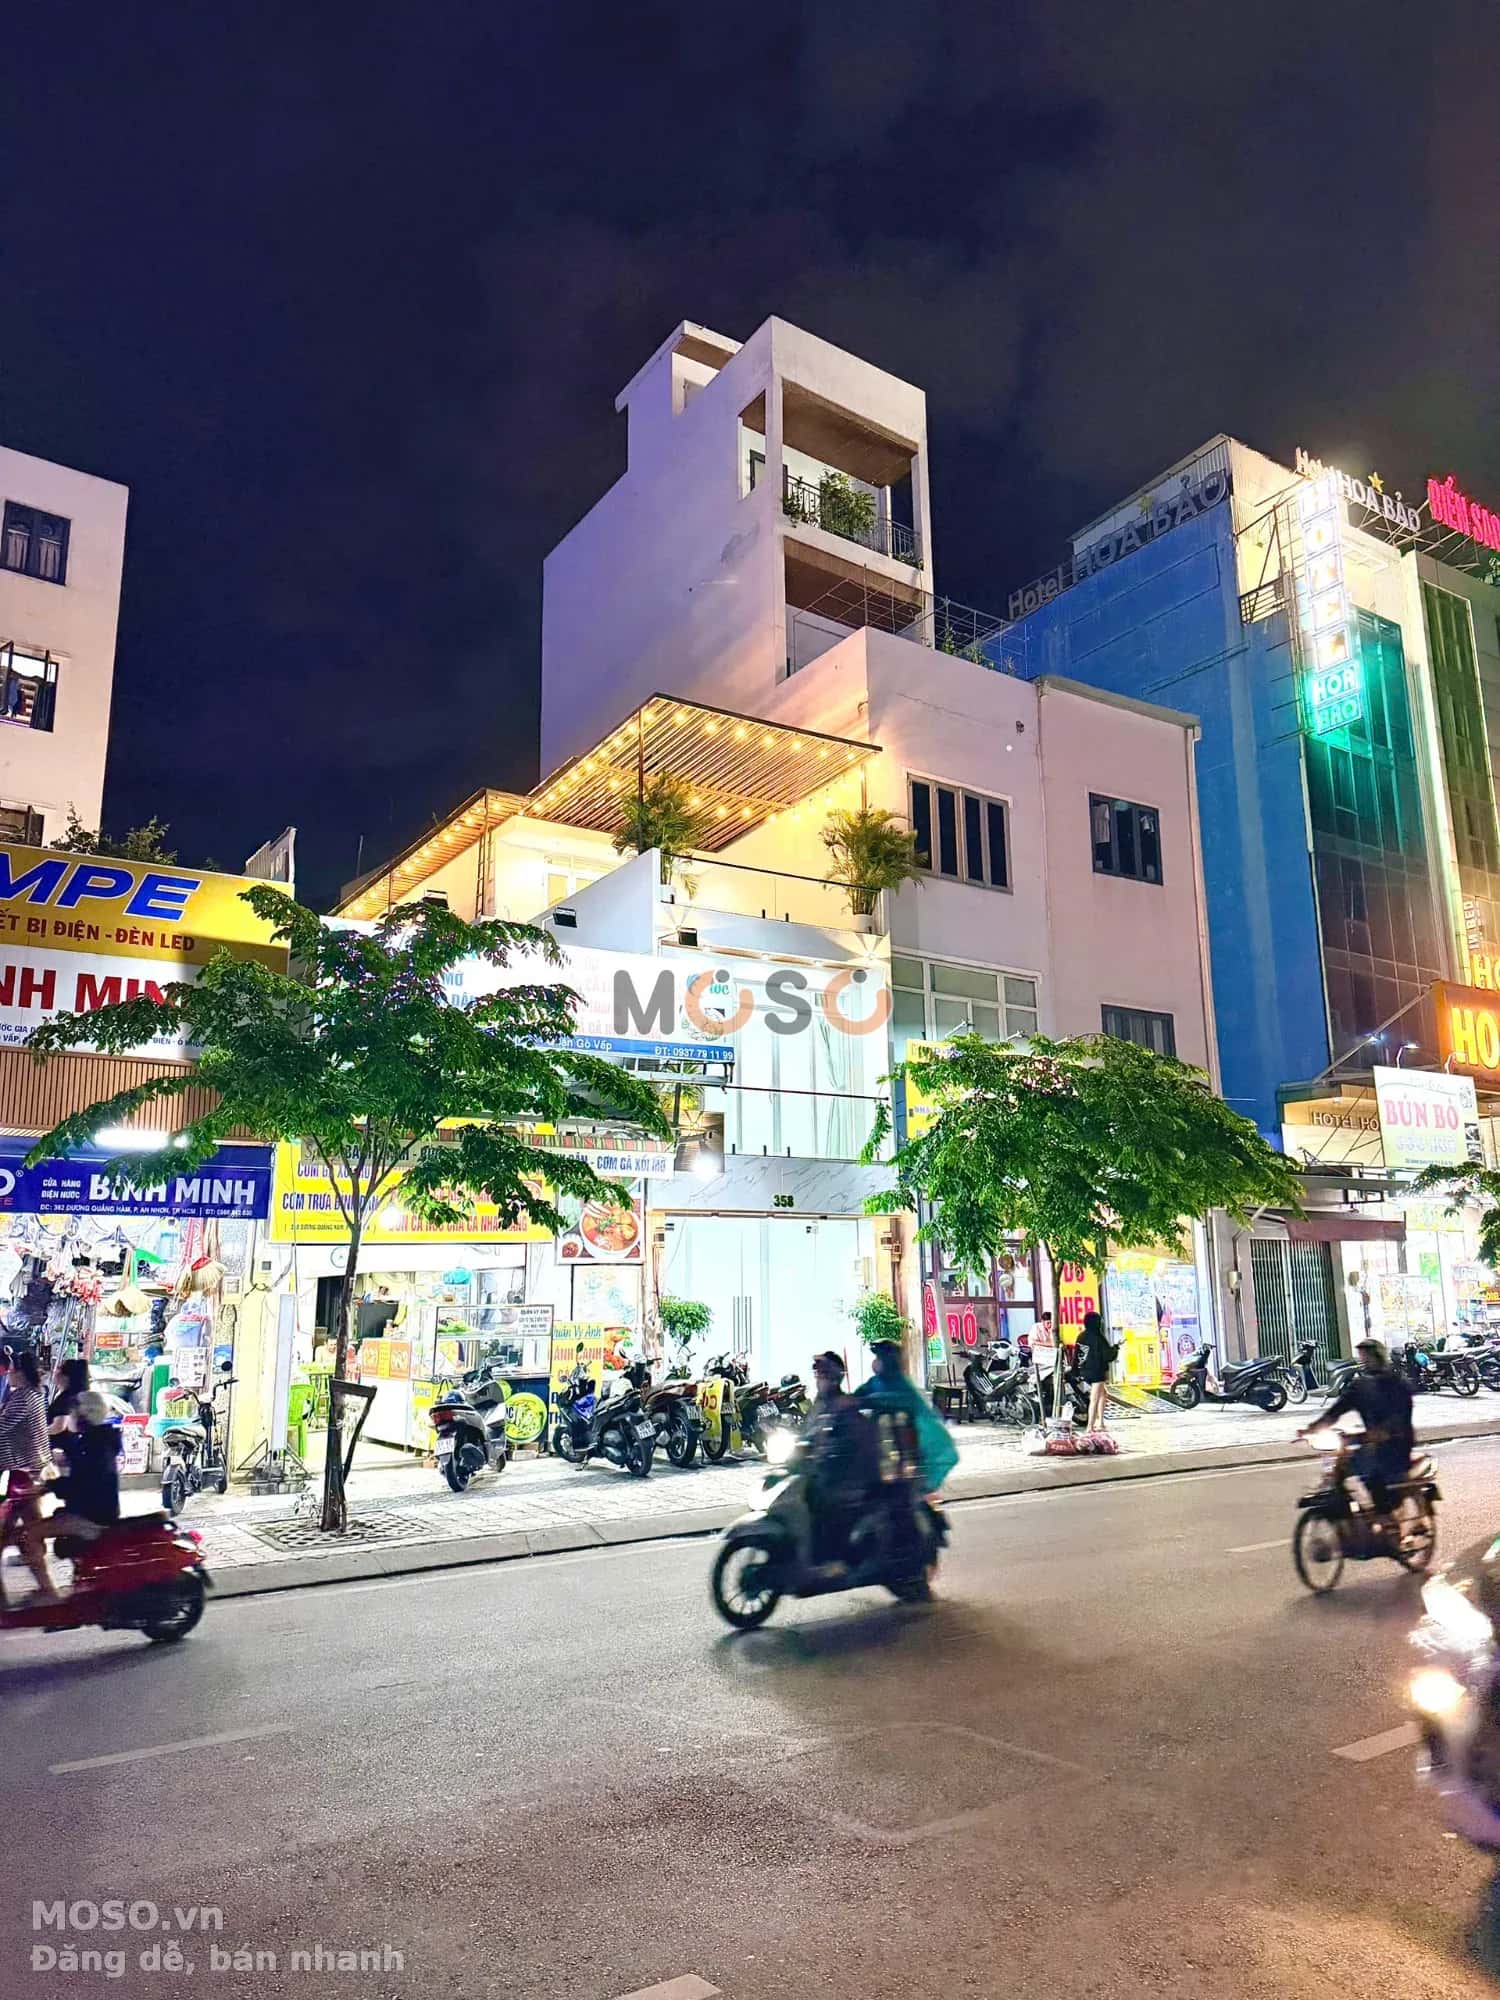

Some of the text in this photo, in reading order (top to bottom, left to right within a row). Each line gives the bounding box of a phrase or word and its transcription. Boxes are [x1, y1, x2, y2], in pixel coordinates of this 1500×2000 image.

[1072, 521, 1142, 584] HOA
[27, 917, 46, 938] BỊ
[54, 919, 100, 942] ĐIỆN
[160, 933, 195, 951] LED
[577, 1037, 591, 1049] Gò
[594, 1038, 612, 1051] Vấp
[655, 1045, 671, 1057] ĐT:
[673, 1047, 695, 1059] 0937
[697, 1049, 708, 1060] 79
[710, 1050, 720, 1060] 11
[722, 1050, 734, 1061] 99
[1312, 1112, 1358, 1129] HOTEL
[597, 1154, 618, 1170] CƠM
[619, 1154, 633, 1171] GÀ
[61, 1178, 81, 1188] HÀNG
[174, 1177, 256, 1205] MINH
[773, 1194, 794, 1208] 358
